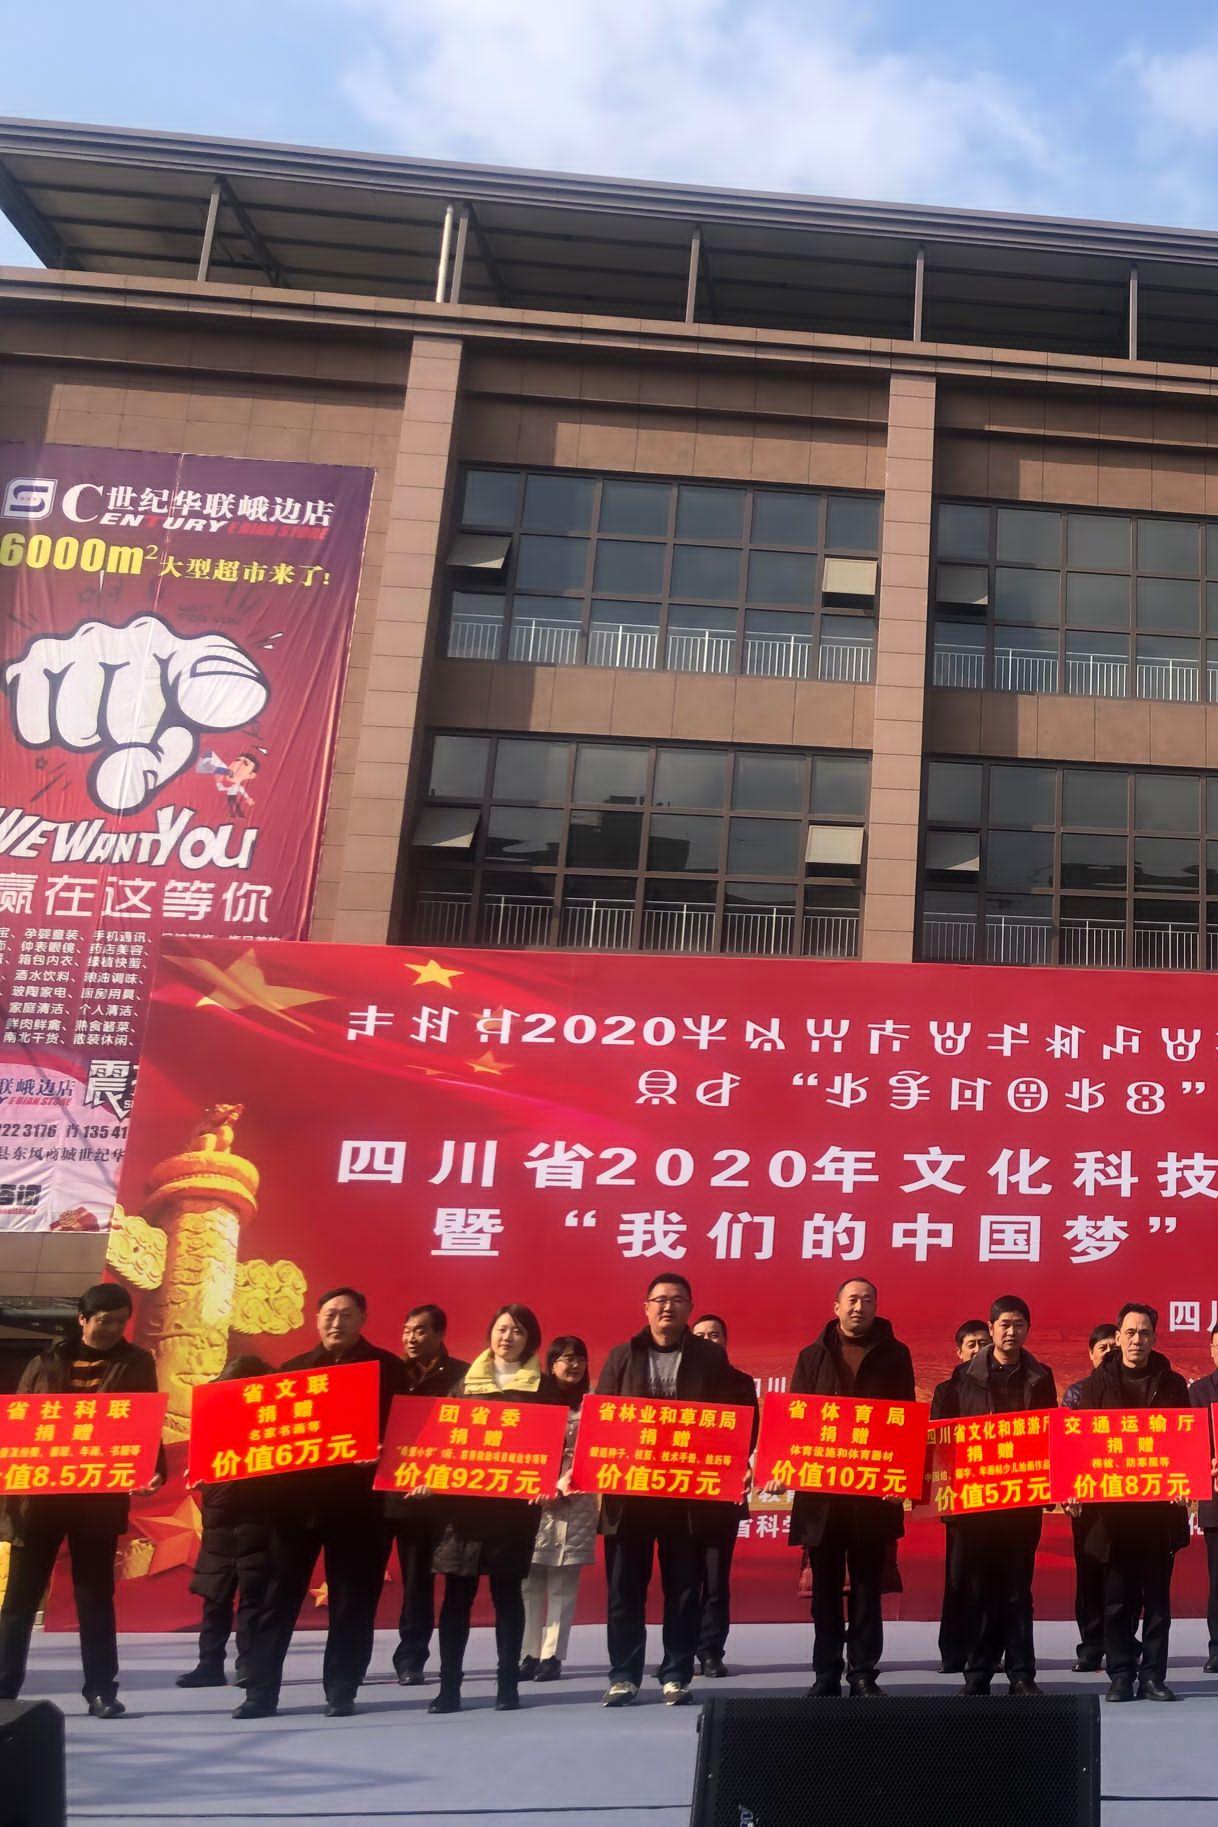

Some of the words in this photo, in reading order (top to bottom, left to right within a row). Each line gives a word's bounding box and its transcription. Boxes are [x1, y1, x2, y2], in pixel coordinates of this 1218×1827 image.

[106, 485, 335, 527] 世纪华联峨边店
[0, 872, 273, 923] 赢在这等你
[243, 1374, 330, 1404] 省文联
[7, 1399, 131, 1420] 省社科联
[258, 1401, 314, 1425] 捐赠
[439, 1404, 521, 1427] 团省委
[599, 1402, 737, 1431] 省林业和草原局
[789, 1400, 905, 1426] 省体育局
[35, 1423, 94, 1441] 捐赠
[820, 1425, 870, 1446] 捐赠
[1064, 1414, 1195, 1435] 交通运输厅
[450, 1427, 503, 1449] 捐赠
[640, 1427, 691, 1448] 捐赠
[1107, 1436, 1155, 1454] 捐赠
[212, 1433, 357, 1478] 价值6万元
[967, 1441, 1014, 1463] 捐赠
[0, 1463, 137, 1490] 值8.5万元
[394, 1461, 542, 1495] 价值92万元
[596, 1463, 721, 1496] 价值5万元
[771, 1459, 908, 1494] 价值10万元
[1074, 1473, 1192, 1498] 价值8万元
[935, 1476, 1051, 1512] 价值5万元
